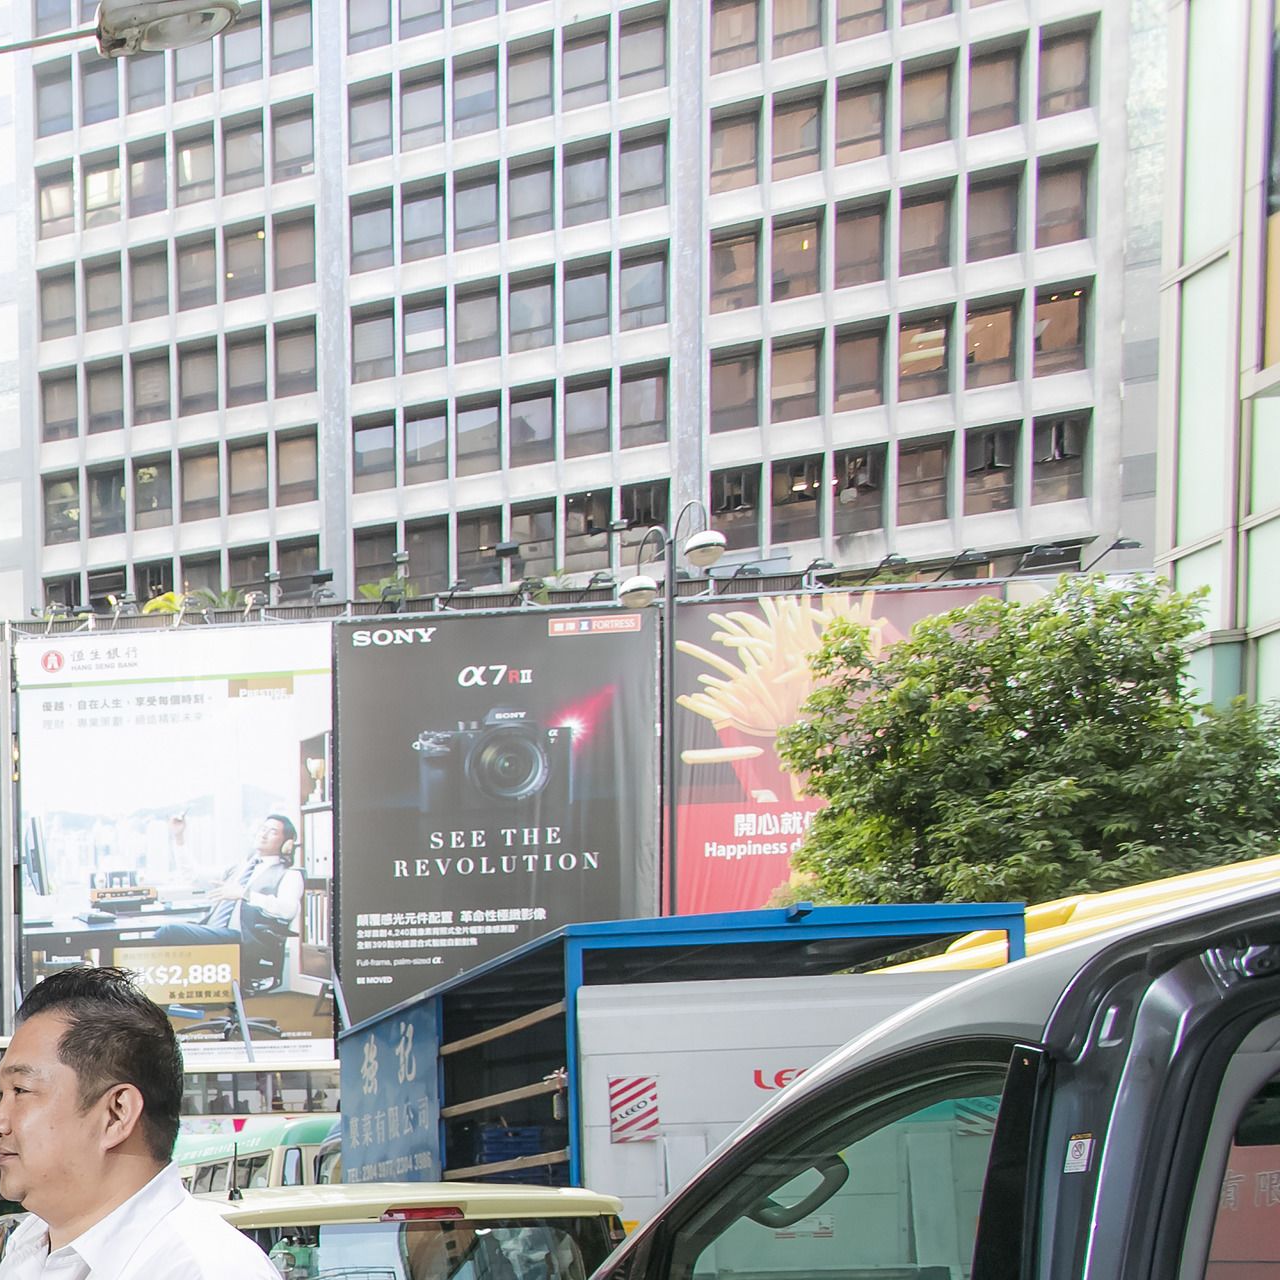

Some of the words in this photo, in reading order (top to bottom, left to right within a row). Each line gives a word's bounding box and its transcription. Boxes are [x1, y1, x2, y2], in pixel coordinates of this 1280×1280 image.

[351, 627, 437, 647] SONY
[495, 711, 527, 719] SONY
[429, 831, 488, 850] SEE
[501, 826, 563, 847] THE
[704, 840, 790, 860] Happiness
[393, 851, 601, 878] REVOLUTION
[133, 964, 232, 985] K$2,888
[366, 976, 393, 984] MOVED
